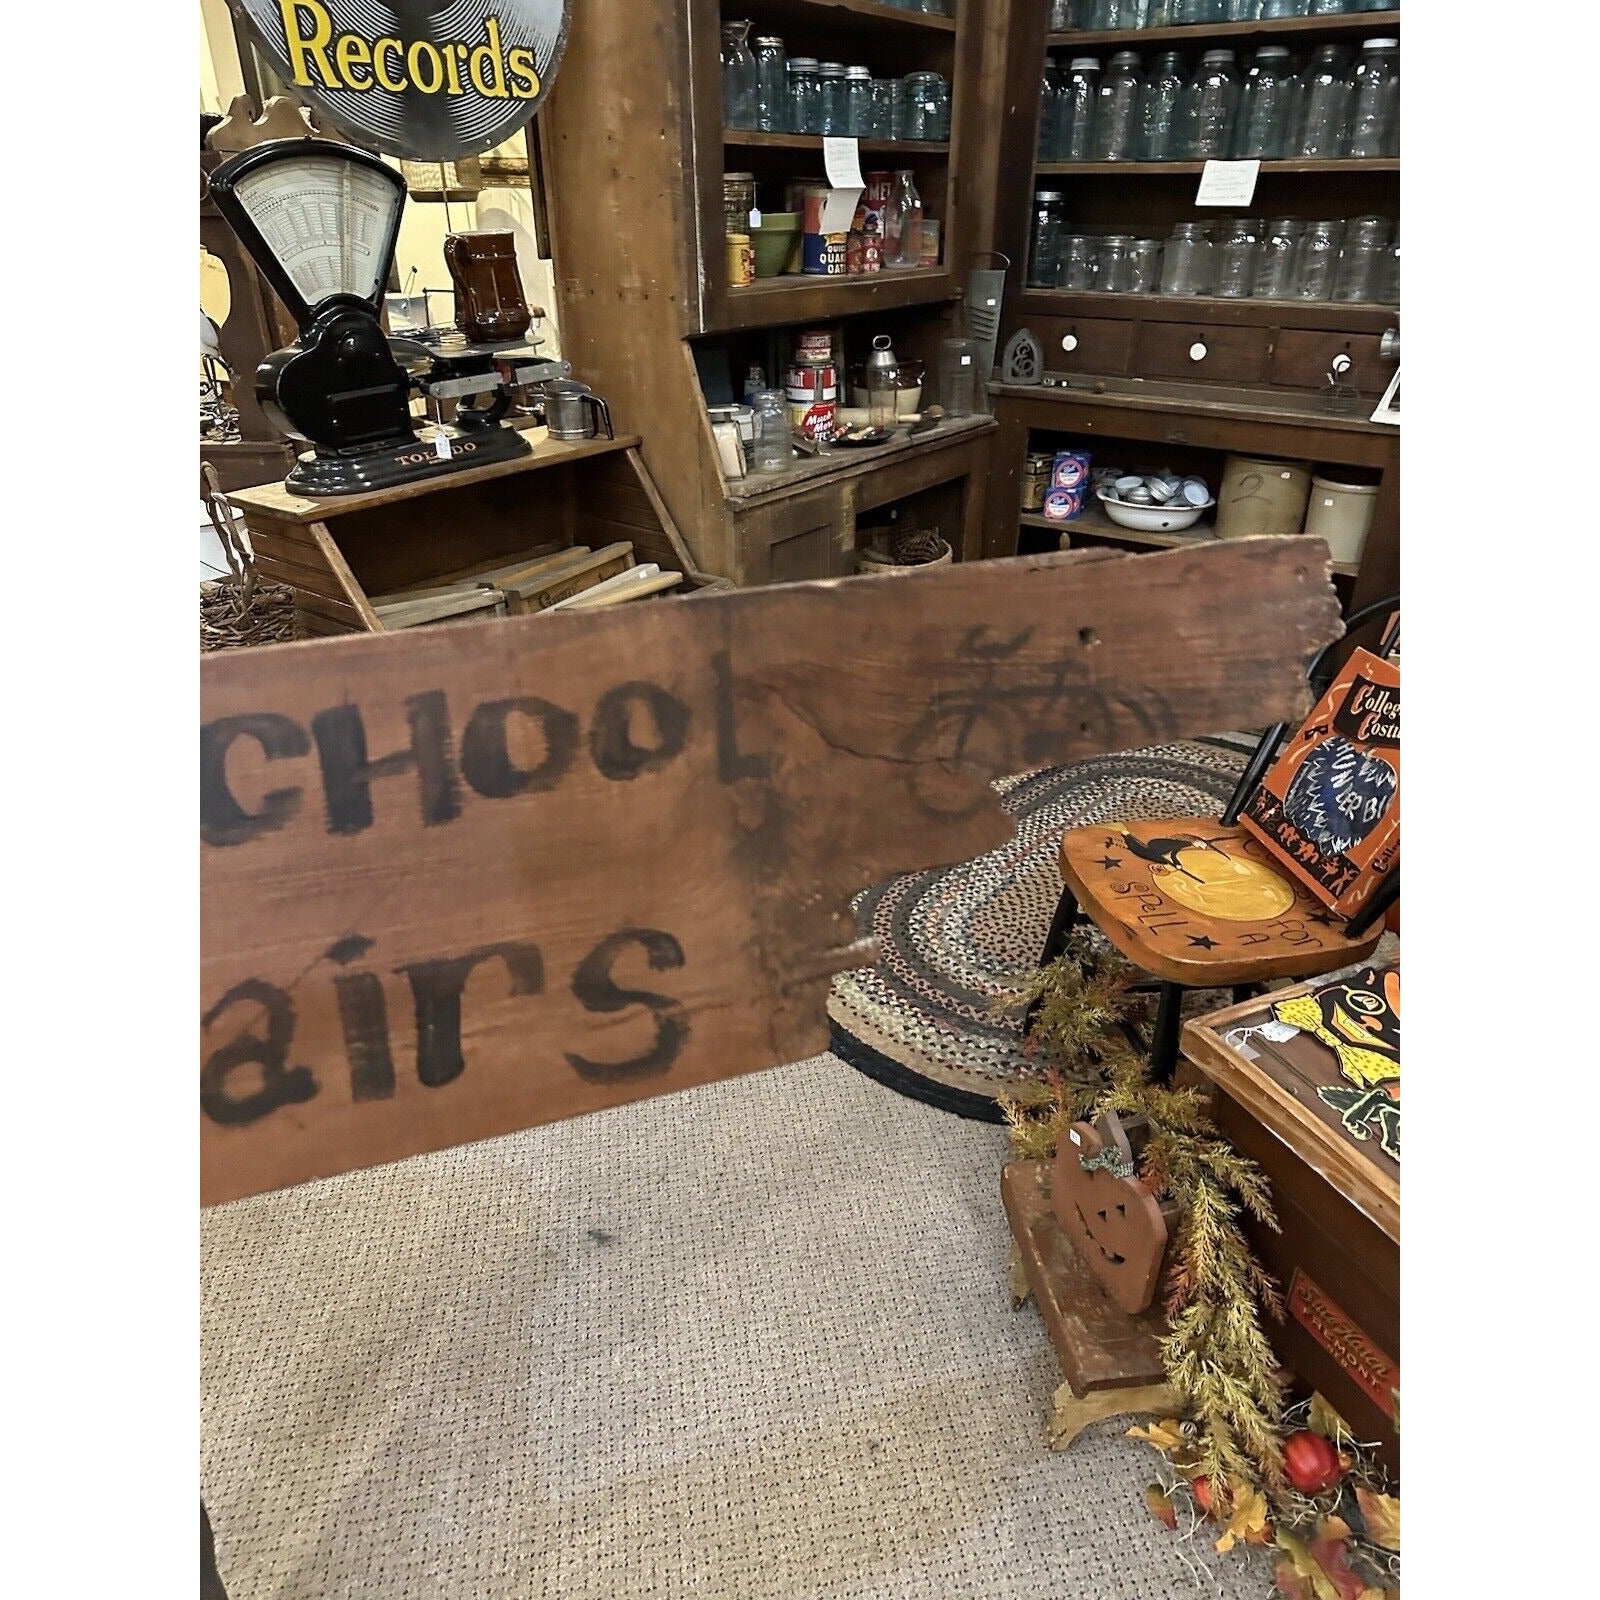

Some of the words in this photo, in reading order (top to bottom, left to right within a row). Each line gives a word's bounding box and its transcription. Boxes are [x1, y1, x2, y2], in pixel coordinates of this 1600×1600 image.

[280, 0, 540, 99] Records
[827, 245, 846, 254] QUIC
[819, 253, 846, 264] QUAK
[394, 442, 476, 465] TOLDO
